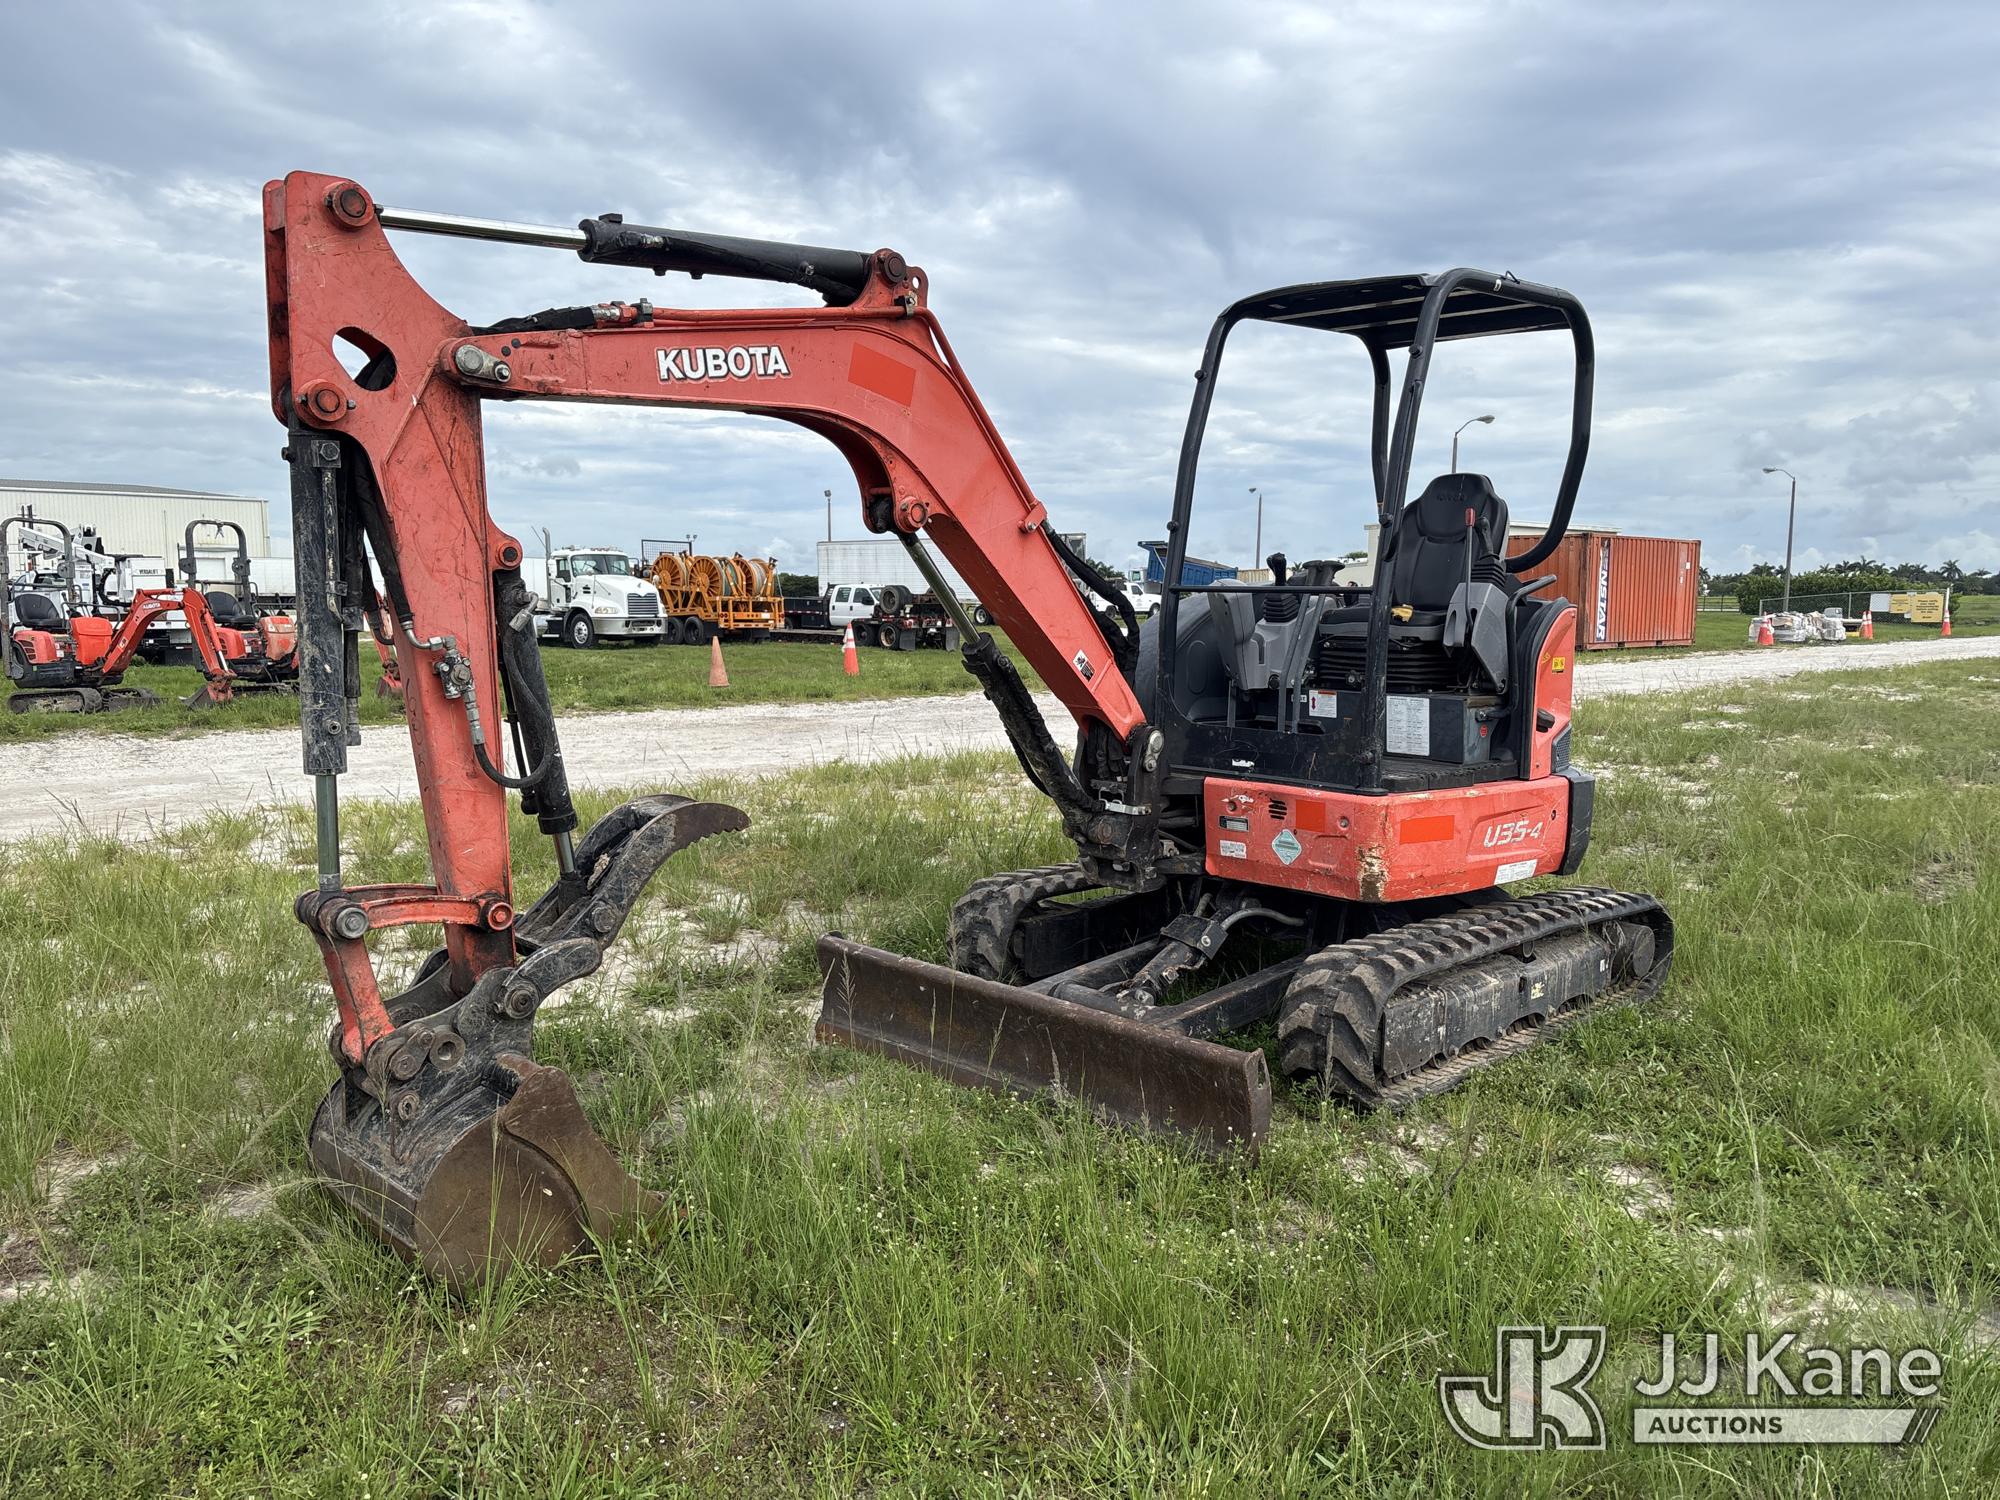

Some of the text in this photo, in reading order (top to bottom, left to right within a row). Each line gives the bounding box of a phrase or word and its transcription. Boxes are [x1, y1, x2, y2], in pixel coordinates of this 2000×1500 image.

[657, 346, 790, 380] KUBOTA
[1596, 547, 1609, 641] ENSTAR
[1484, 820, 1543, 848] U35-4
